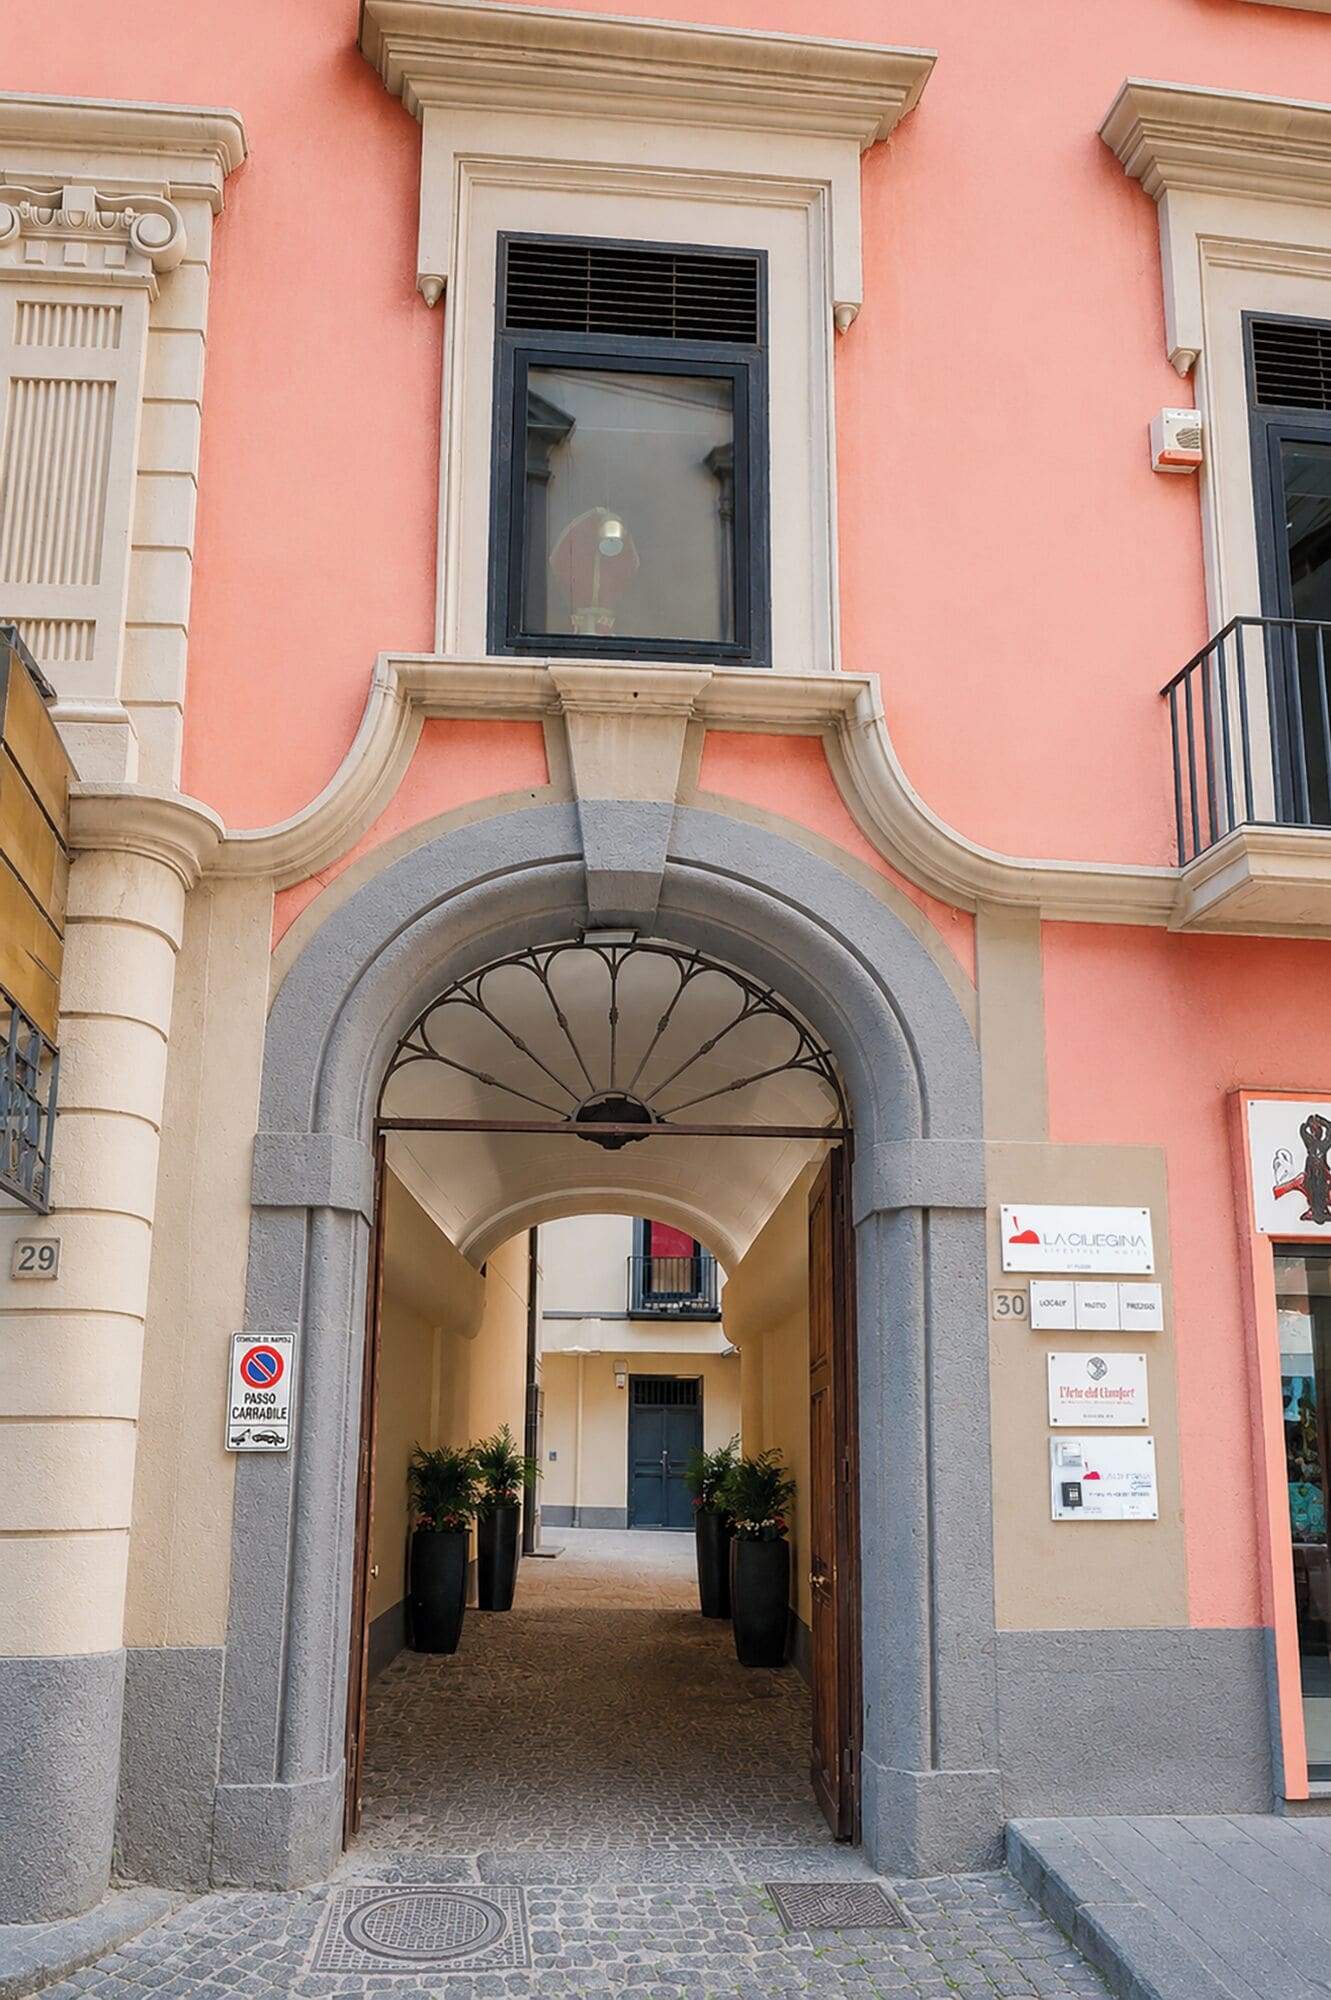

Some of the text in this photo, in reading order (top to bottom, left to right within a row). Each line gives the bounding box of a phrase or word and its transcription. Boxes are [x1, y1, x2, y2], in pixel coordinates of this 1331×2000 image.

[1043, 1233, 1146, 1247] LA CILIEGINA
[18, 1245, 55, 1271] 29
[996, 1294, 1025, 1316] 30
[244, 1392, 276, 1404] PASSO
[232, 1406, 287, 1420] CARRABILE
